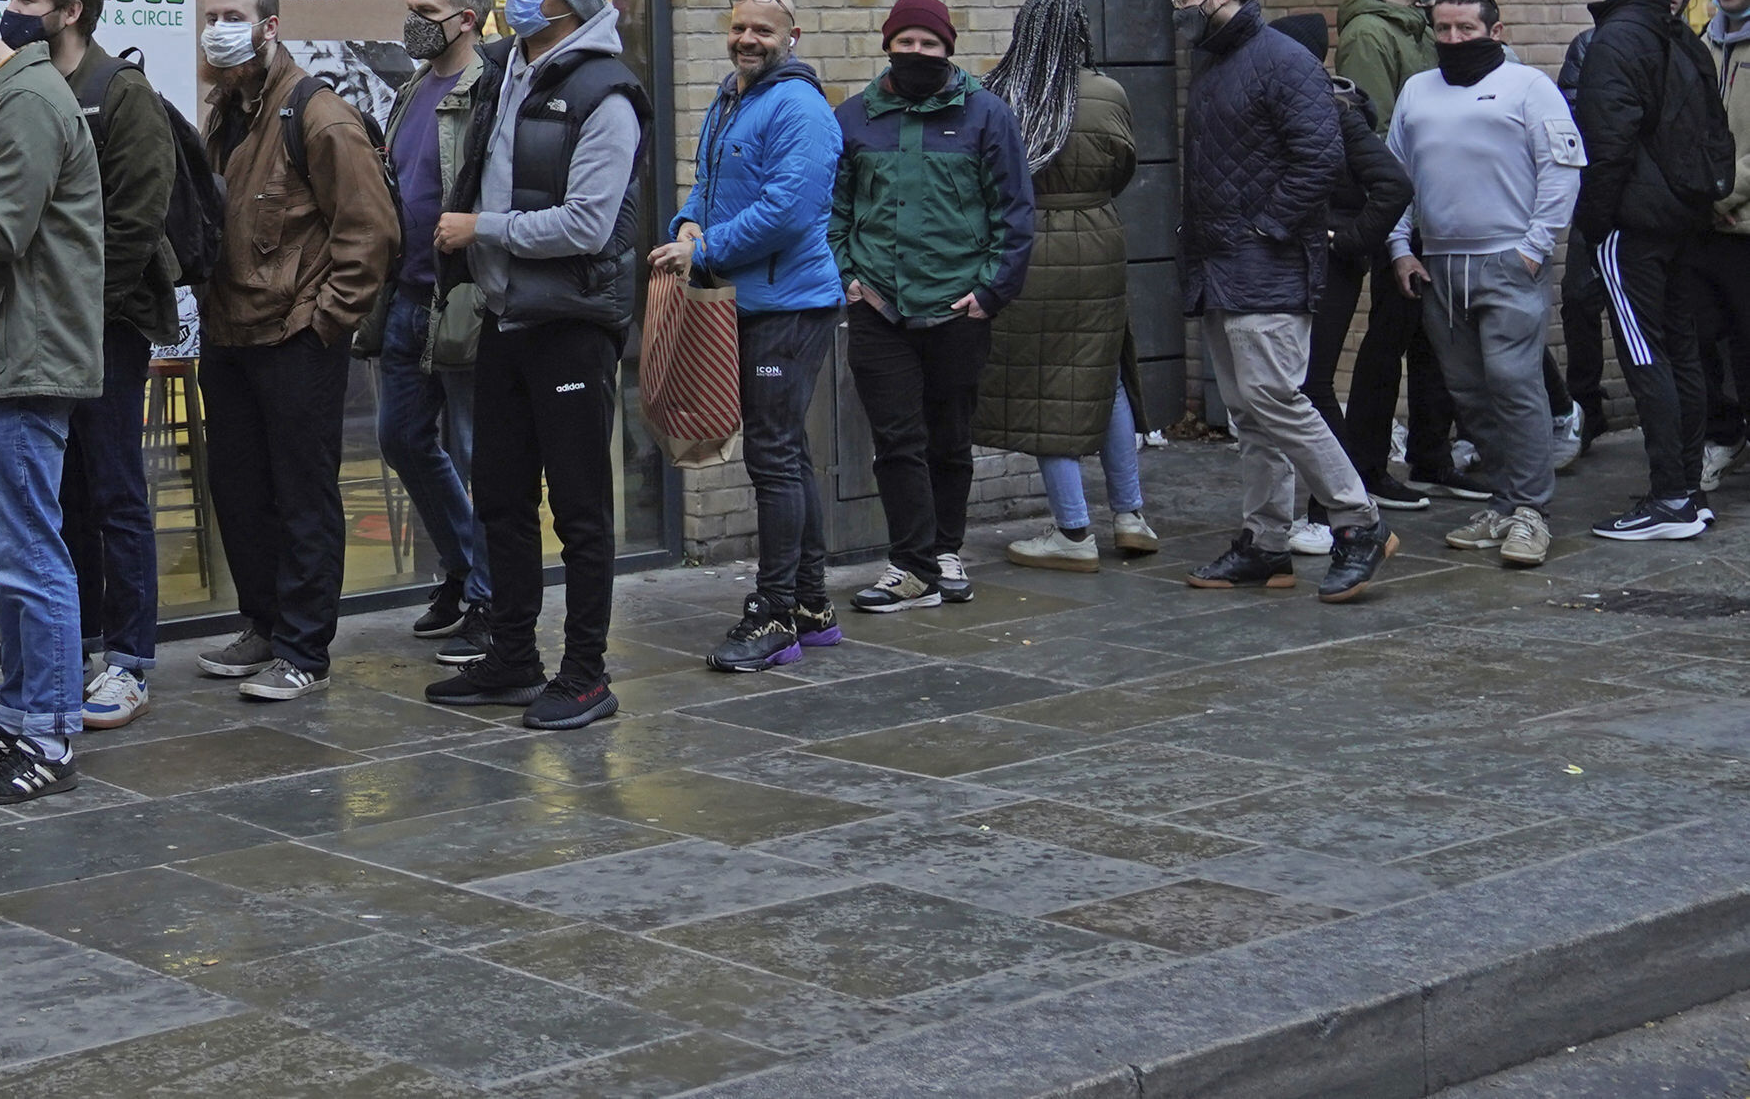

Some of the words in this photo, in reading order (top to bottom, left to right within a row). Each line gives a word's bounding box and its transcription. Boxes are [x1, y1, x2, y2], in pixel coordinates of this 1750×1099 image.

[114, 9, 126, 25] &
[132, 9, 183, 27] CIRCLE
[556, 382, 586, 393] adidas
